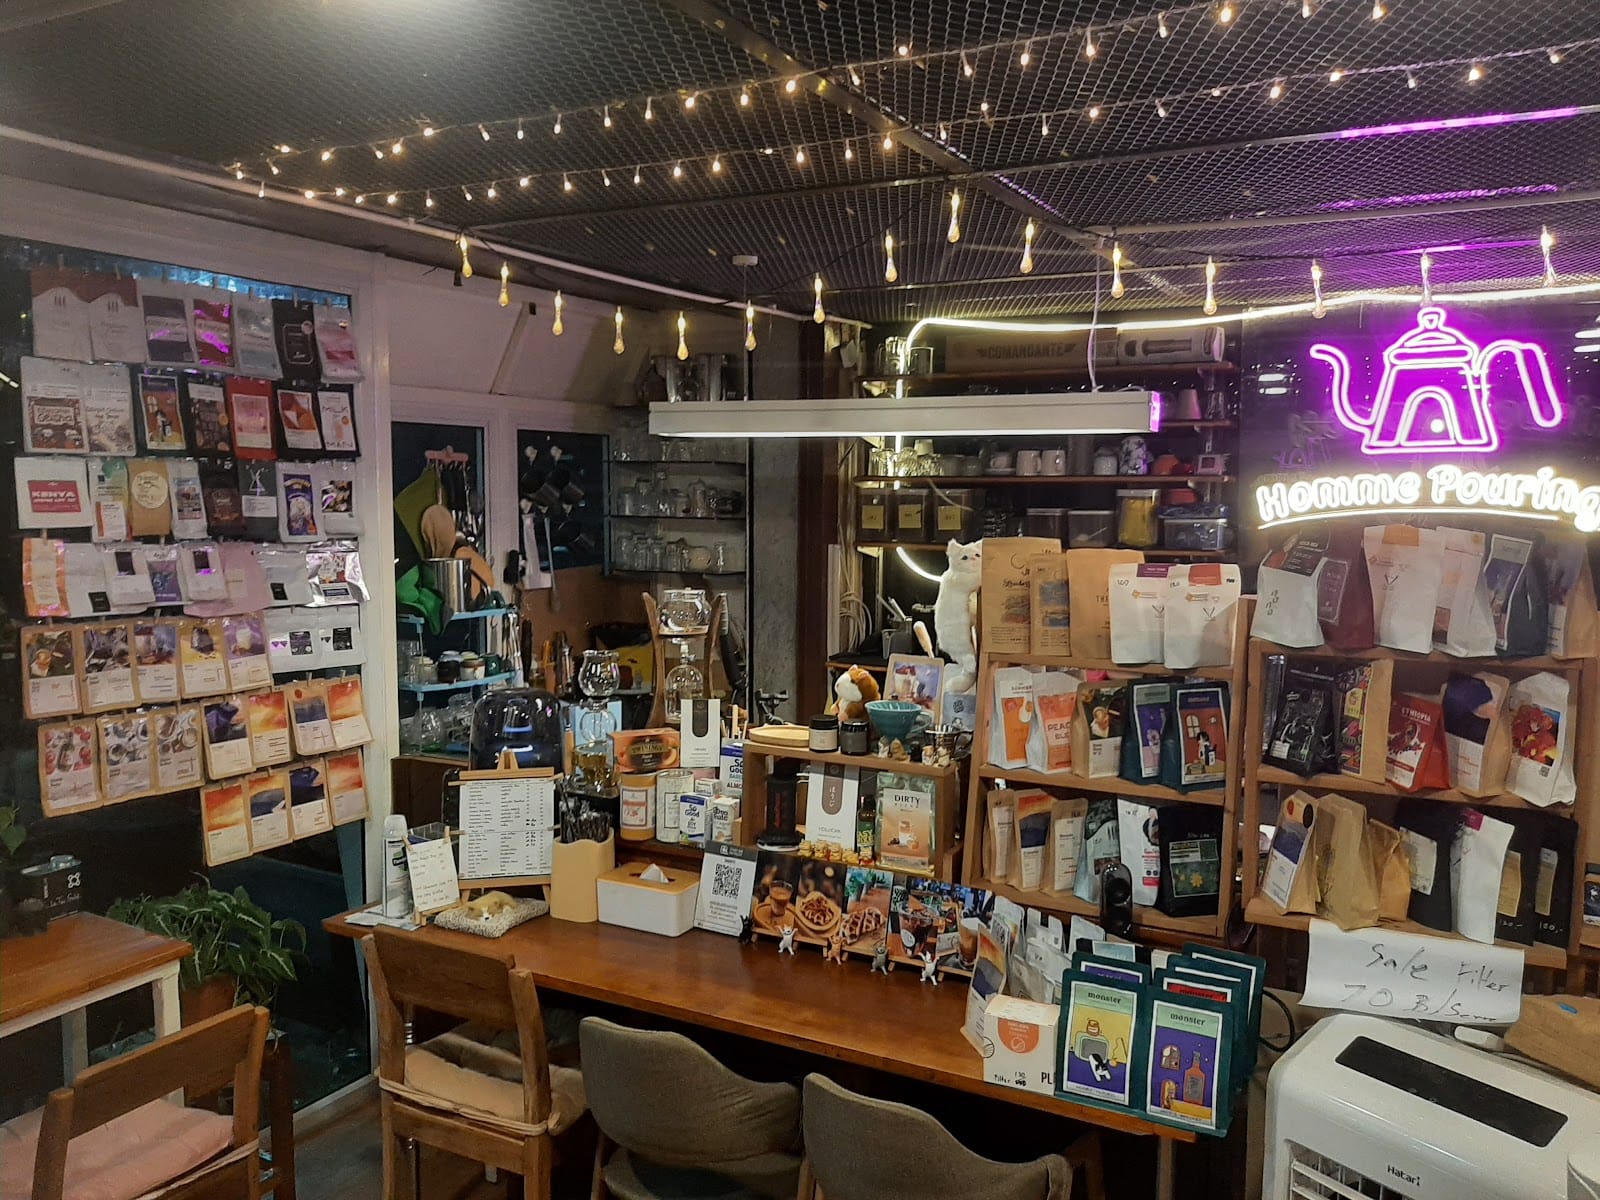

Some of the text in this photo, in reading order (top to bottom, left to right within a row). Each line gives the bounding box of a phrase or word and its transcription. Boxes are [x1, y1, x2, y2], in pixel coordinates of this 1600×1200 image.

[987, 342, 1065, 360] COMANDANTE
[1256, 463, 1600, 532] Homme Pouring
[1401, 706, 1432, 722] ETHIOPIA
[1047, 721, 1071, 731] PEAC
[894, 794, 921, 806] DIRTY
[1366, 943, 1510, 993] Sale Filter
[1087, 991, 1122, 1005] monster
[1340, 983, 1394, 1007] 70
[1170, 1012, 1206, 1026] monster
[1041, 1072, 1056, 1085] PL
[1387, 1164, 1420, 1187] Hatari
